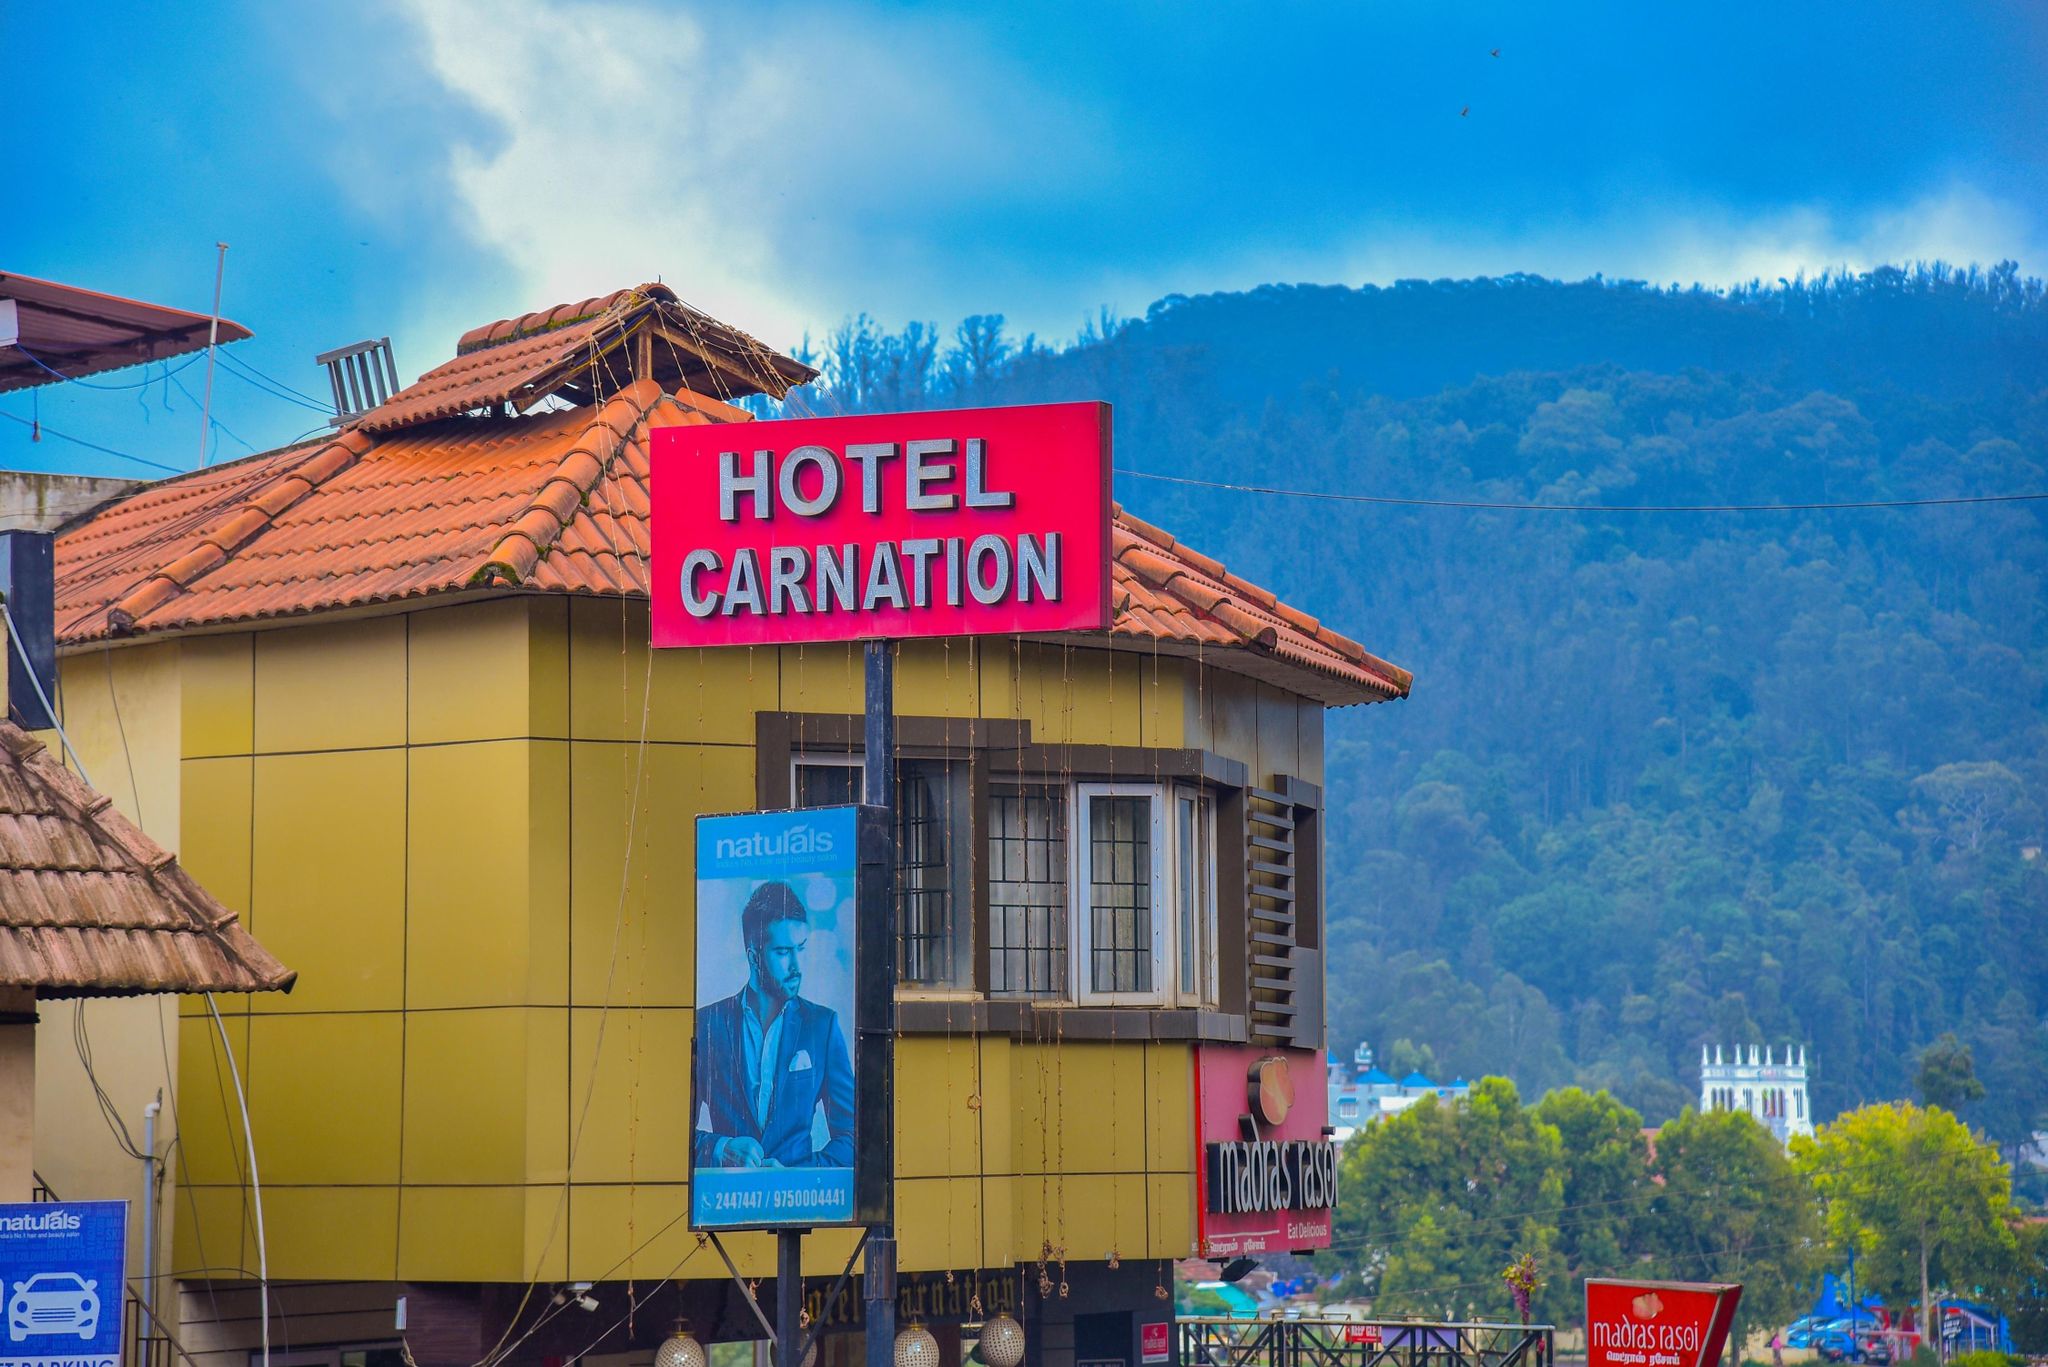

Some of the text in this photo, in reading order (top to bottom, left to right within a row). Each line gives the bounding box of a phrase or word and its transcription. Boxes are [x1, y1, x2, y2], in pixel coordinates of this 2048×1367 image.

[718, 438, 1016, 521] HOTEL
[680, 532, 1063, 618] CARNATION
[716, 824, 834, 859] naturals
[1219, 1113, 1339, 1214] madras rasoi
[715, 1190, 763, 1210] 2447447
[774, 1188, 845, 1208] 9750004441
[0, 1209, 80, 1231] naturals
[1287, 1221, 1327, 1239] Eat Delicious
[1593, 1314, 1699, 1351] madras rasoi
